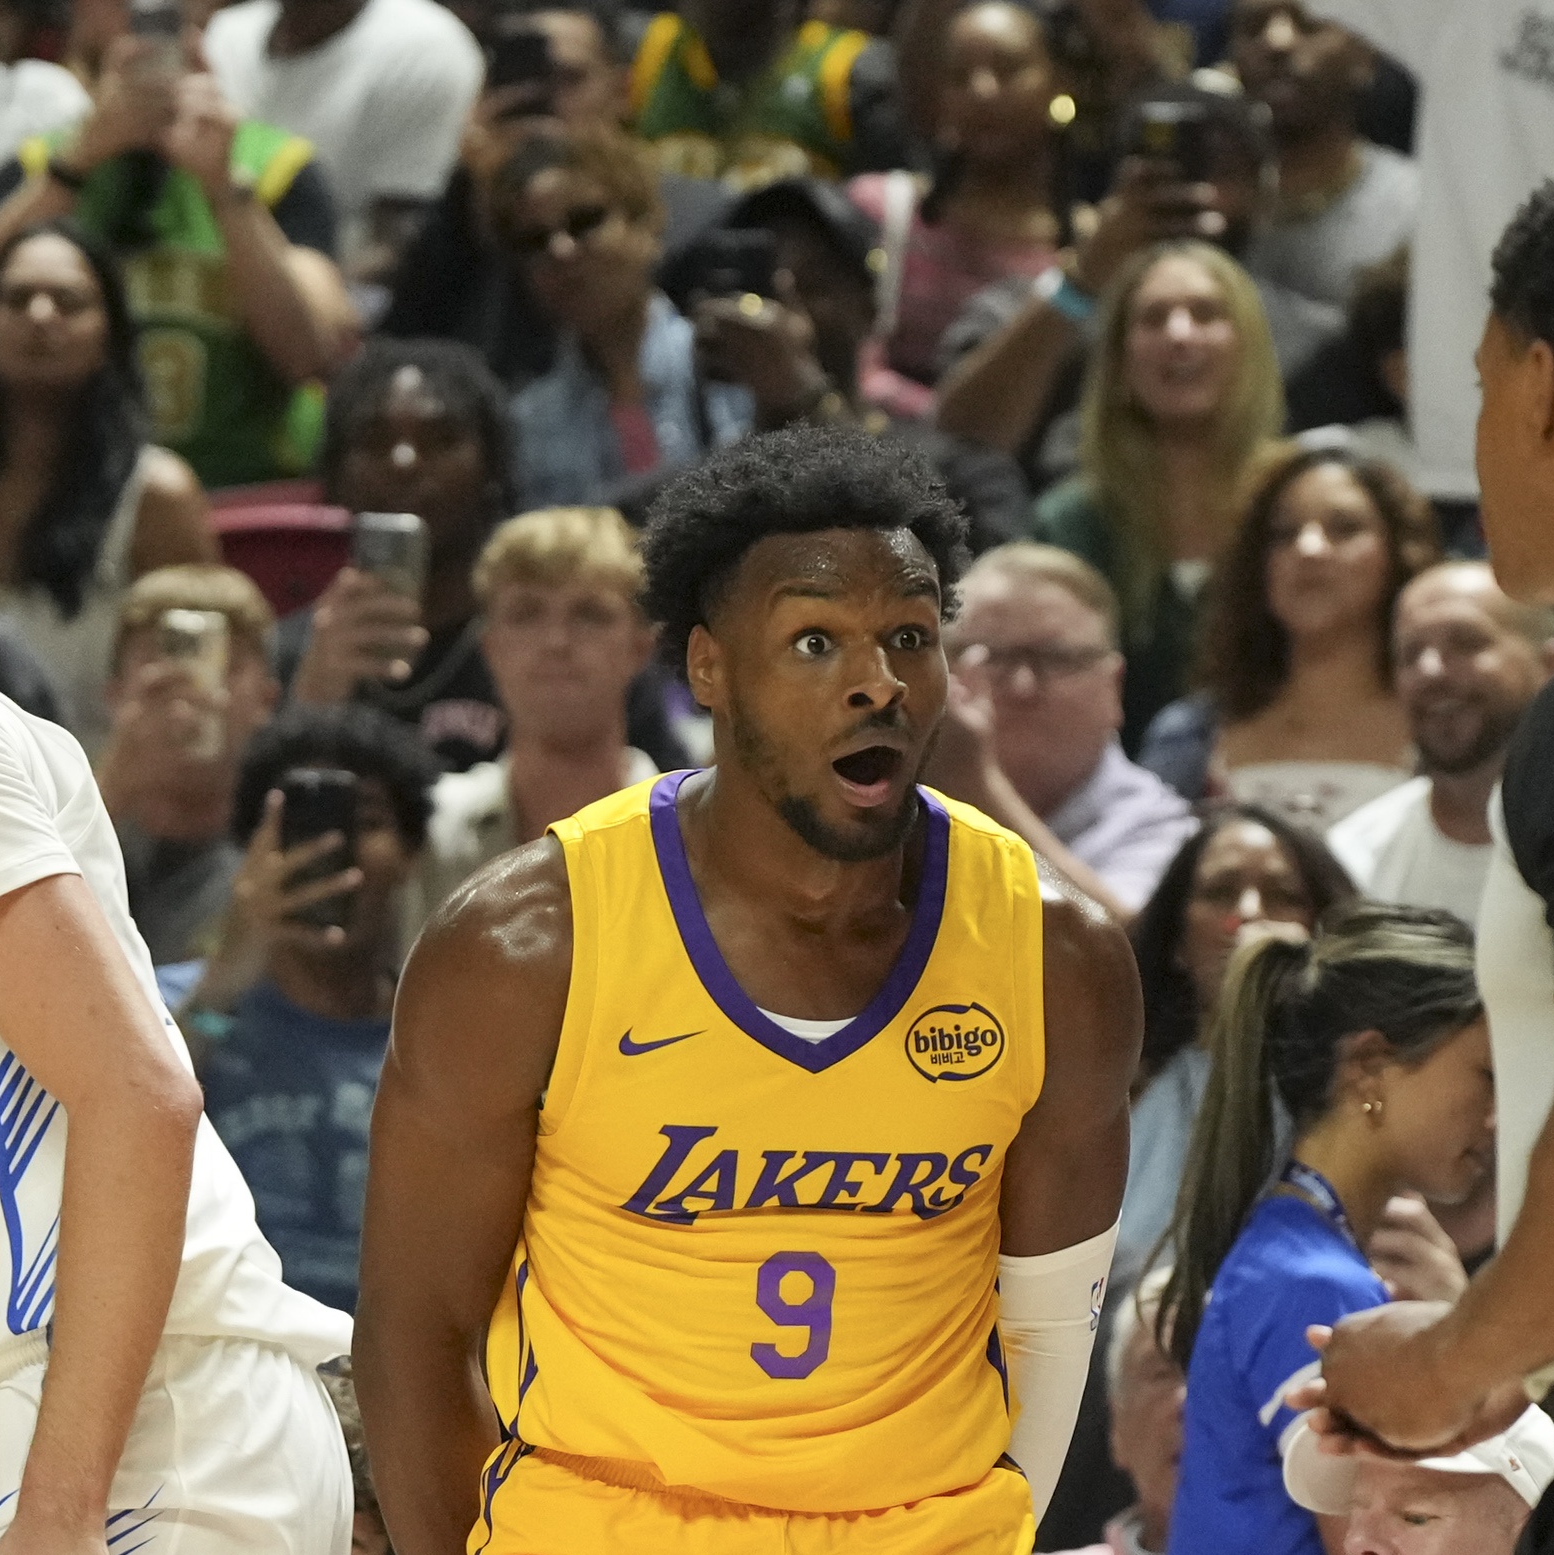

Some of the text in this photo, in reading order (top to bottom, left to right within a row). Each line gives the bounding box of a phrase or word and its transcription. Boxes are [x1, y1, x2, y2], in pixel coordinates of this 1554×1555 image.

[914, 1024, 998, 1057] bibigo
[930, 1051, 966, 1066] 비비고
[620, 1124, 995, 1226] LAKERS
[750, 1251, 836, 1380] 9
